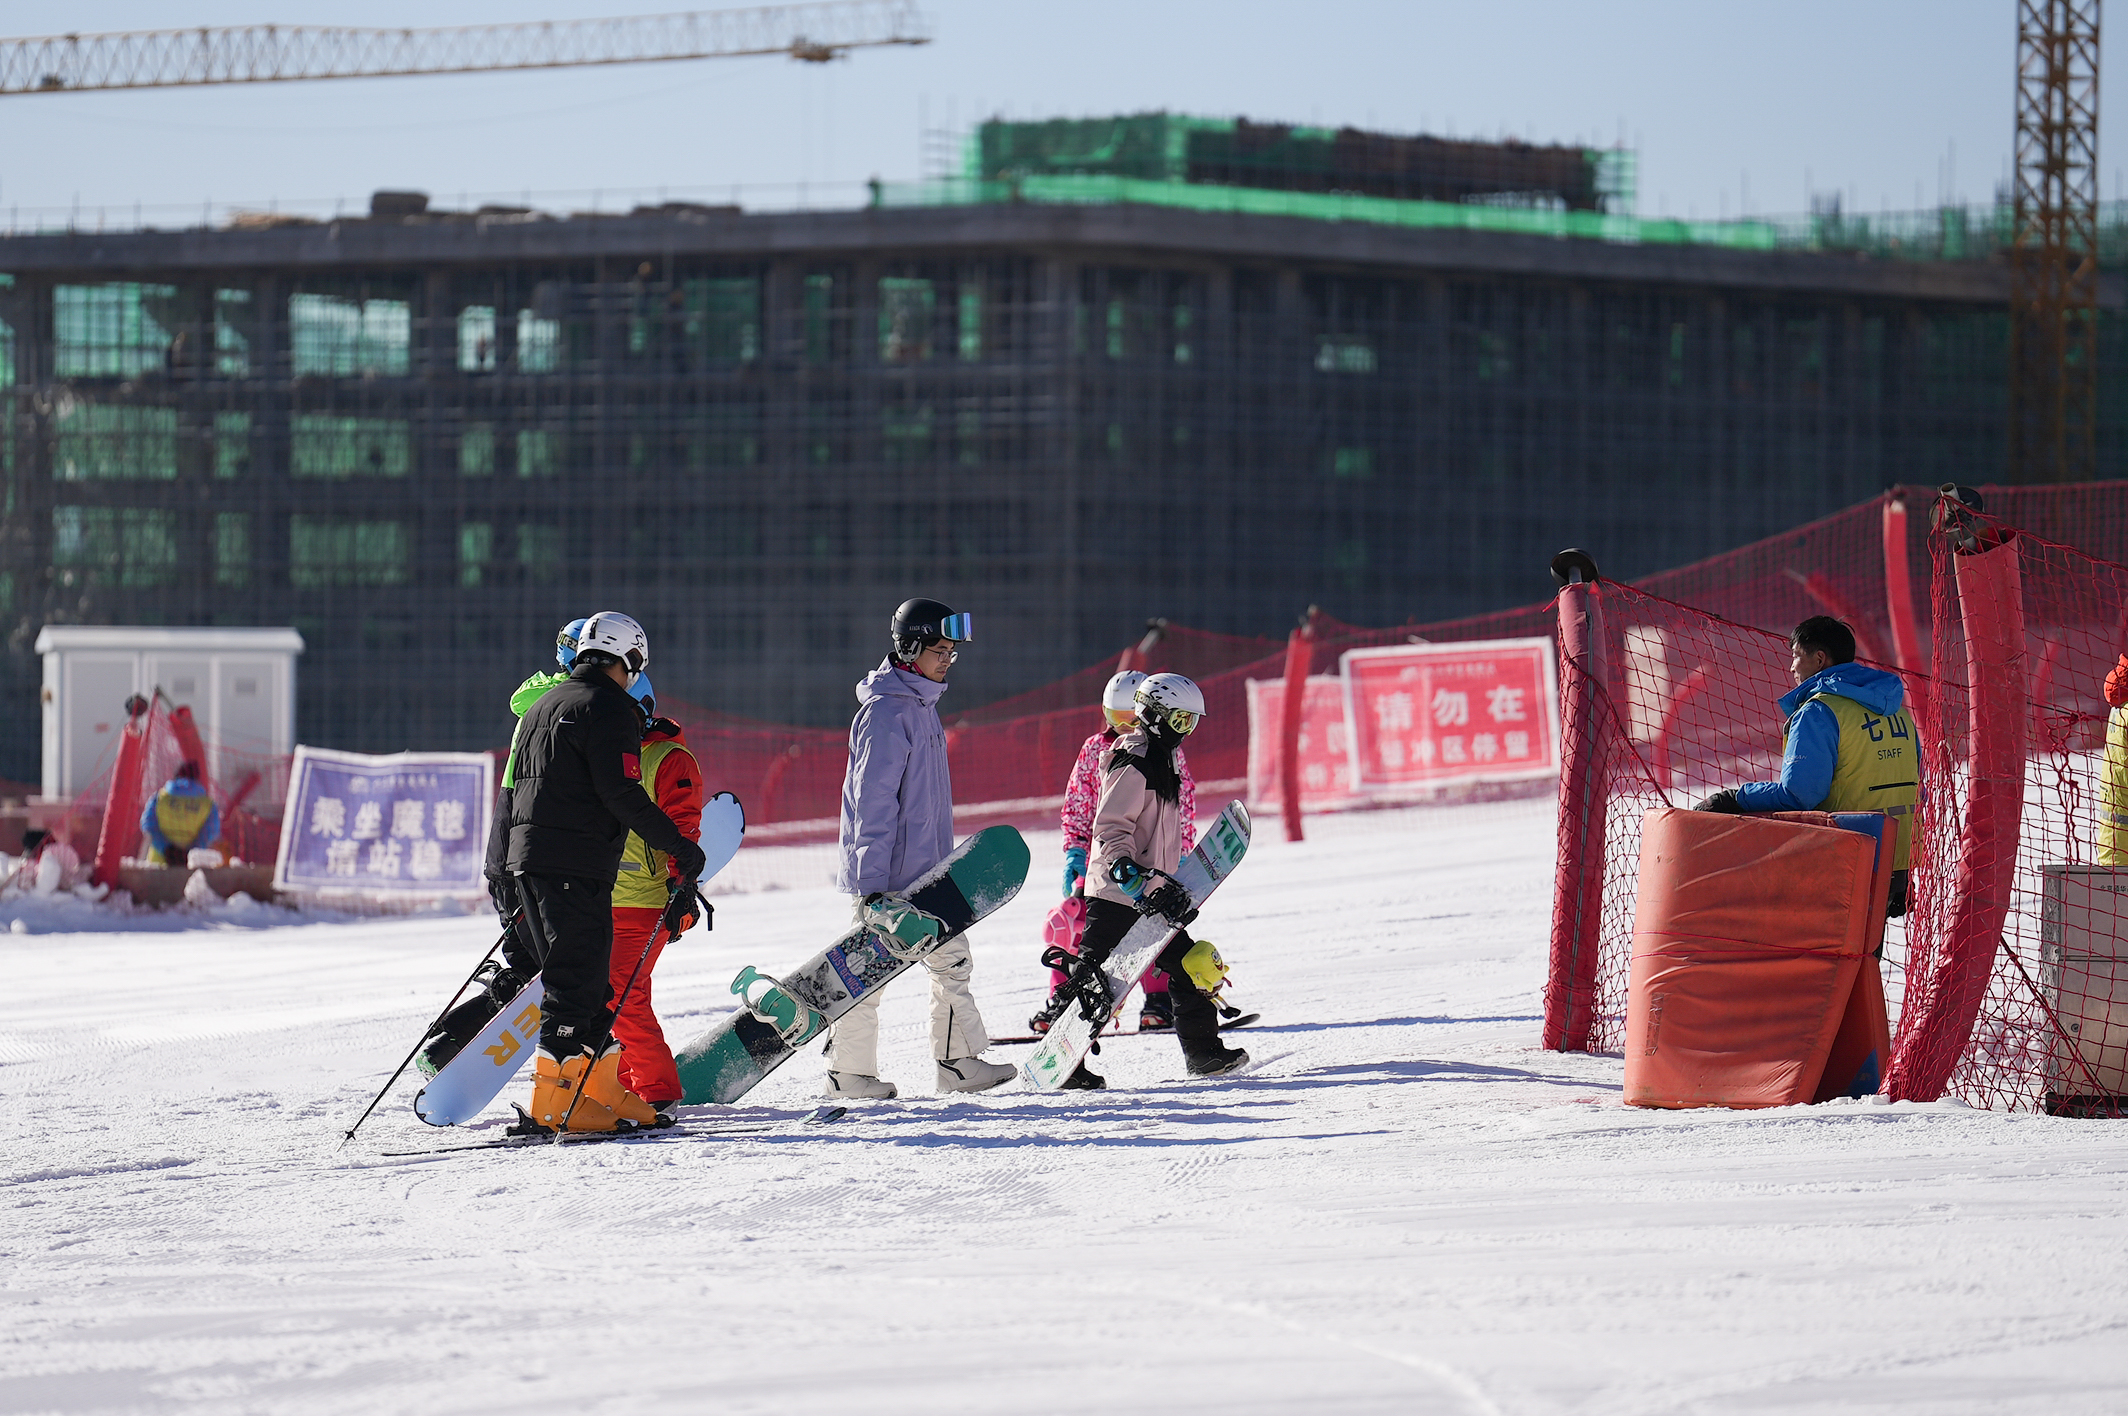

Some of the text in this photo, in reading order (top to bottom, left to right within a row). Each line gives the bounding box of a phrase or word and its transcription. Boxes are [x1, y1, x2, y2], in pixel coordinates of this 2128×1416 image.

[1374, 684, 1527, 730] 请勿在
[1861, 712, 1909, 742] 七山
[1877, 748, 1902, 761] STAFF
[310, 795, 466, 841] 乘坐魔毯
[326, 837, 443, 880] 请站稳
[846, 979, 863, 996] NICE
